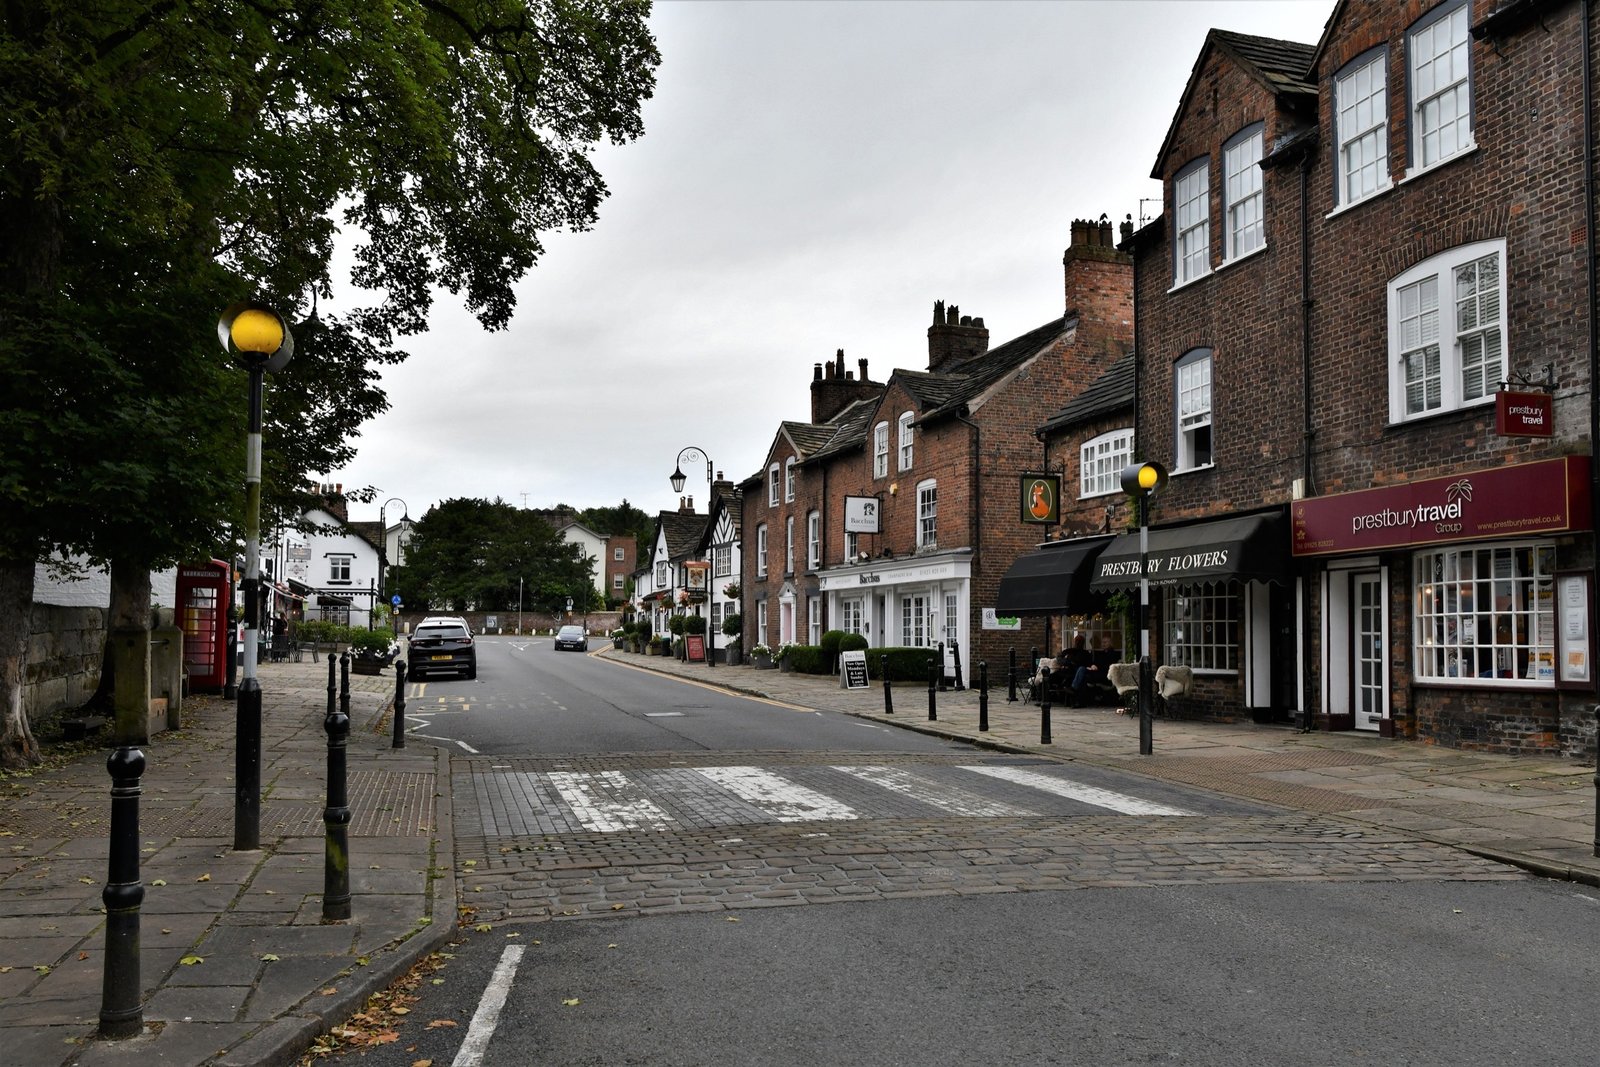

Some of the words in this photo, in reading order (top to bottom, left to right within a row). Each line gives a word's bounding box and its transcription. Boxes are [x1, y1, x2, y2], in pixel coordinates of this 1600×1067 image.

[1508, 405, 1543, 416] prestbury
[1522, 415, 1543, 425] travel
[850, 517, 875, 525] Bacchus
[1352, 497, 1462, 535] prestburytravel
[1476, 514, 1562, 531] www.prestburytravel.co.uk
[1435, 522, 1463, 535] Group
[1167, 549, 1229, 571] FLOWERS
[182, 570, 221, 578] TELEPHONE
[859, 572, 881, 585] Bacchus
